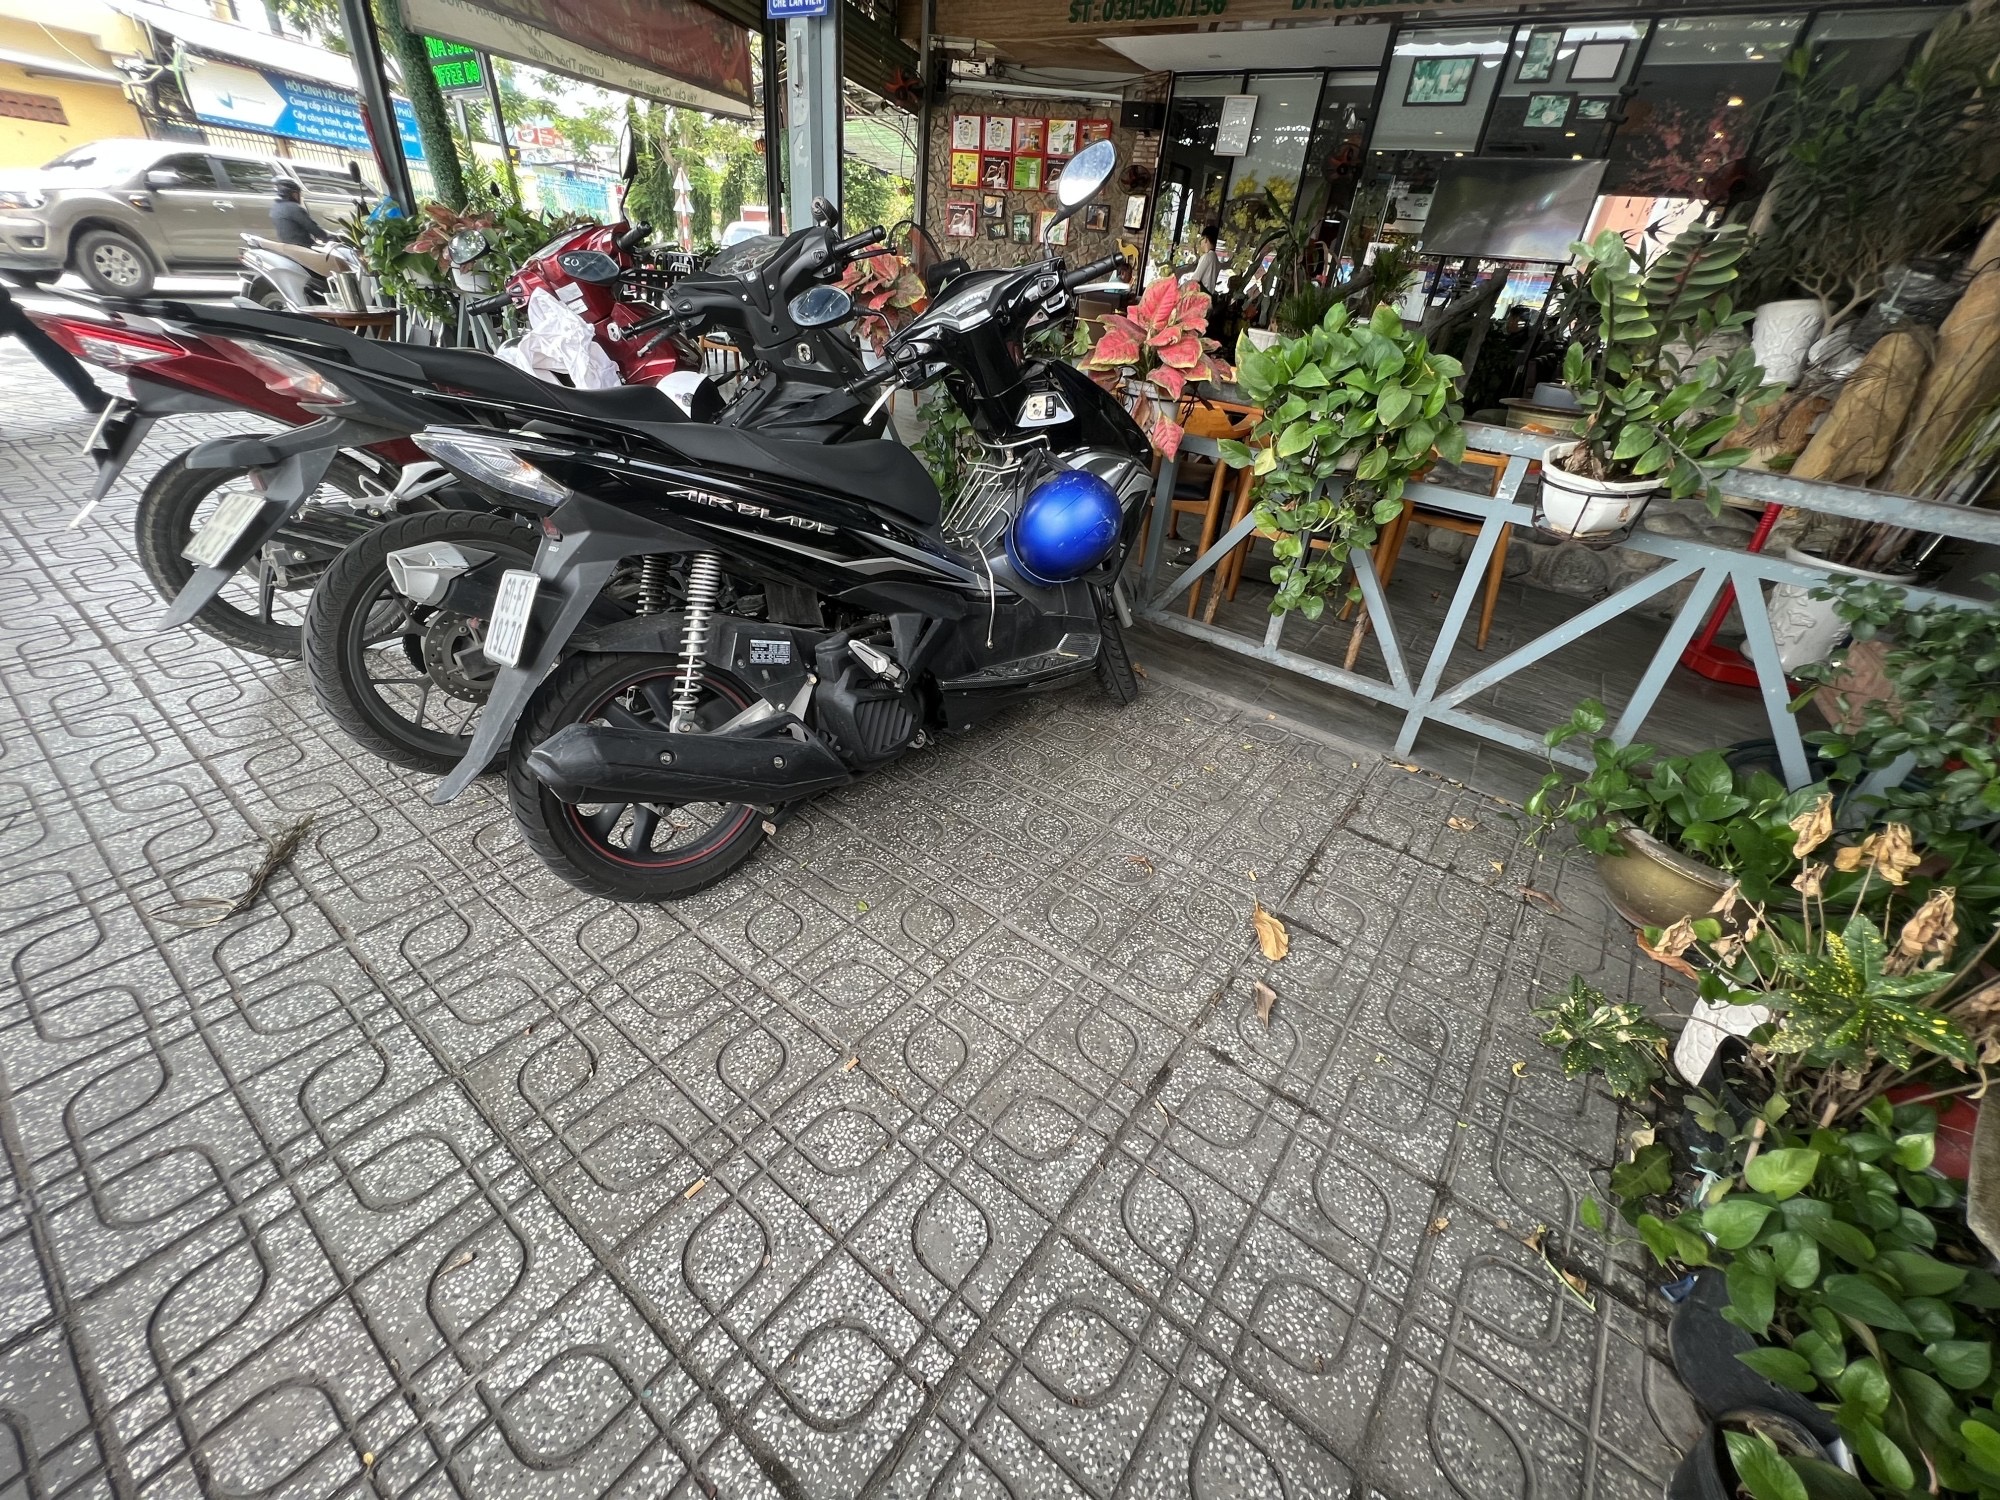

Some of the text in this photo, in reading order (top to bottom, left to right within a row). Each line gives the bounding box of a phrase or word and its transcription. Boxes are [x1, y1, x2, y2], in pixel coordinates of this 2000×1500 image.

[433, 62, 465, 87] OFFEE
[666, 489, 839, 536] AIR BLADE
